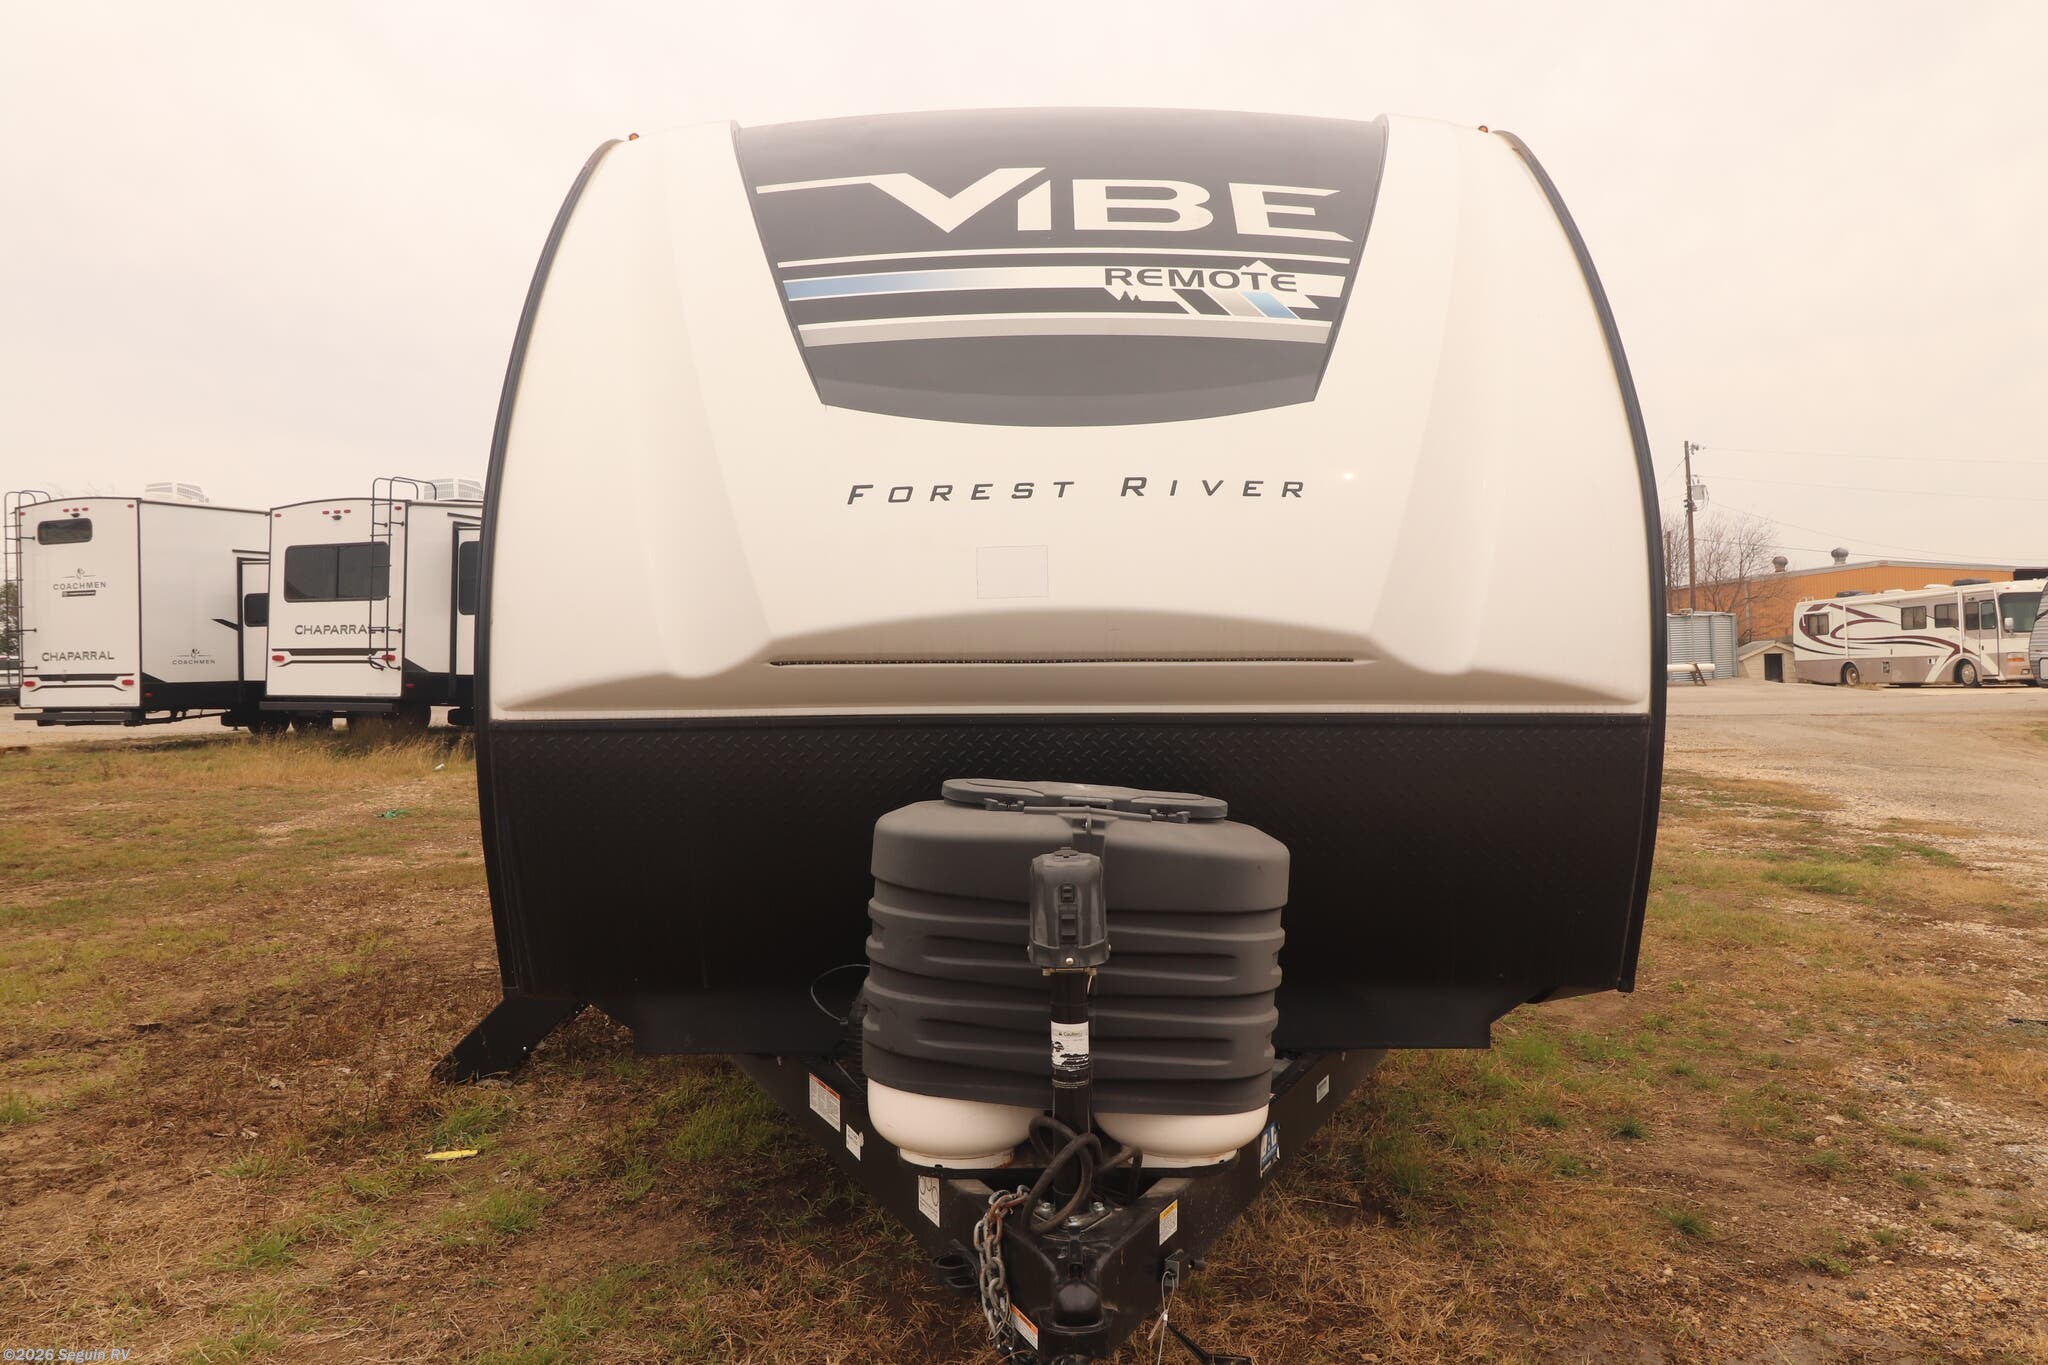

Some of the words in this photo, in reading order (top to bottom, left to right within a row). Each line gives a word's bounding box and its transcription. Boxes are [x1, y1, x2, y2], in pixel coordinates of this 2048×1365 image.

[756, 167, 1354, 242] VIBE
[1104, 267, 1298, 293] REMOTE
[847, 481, 1075, 505] FOREST
[1120, 476, 1305, 498] RIVER
[53, 581, 107, 591] COACHMEN
[41, 650, 115, 662] CHAPARRAL
